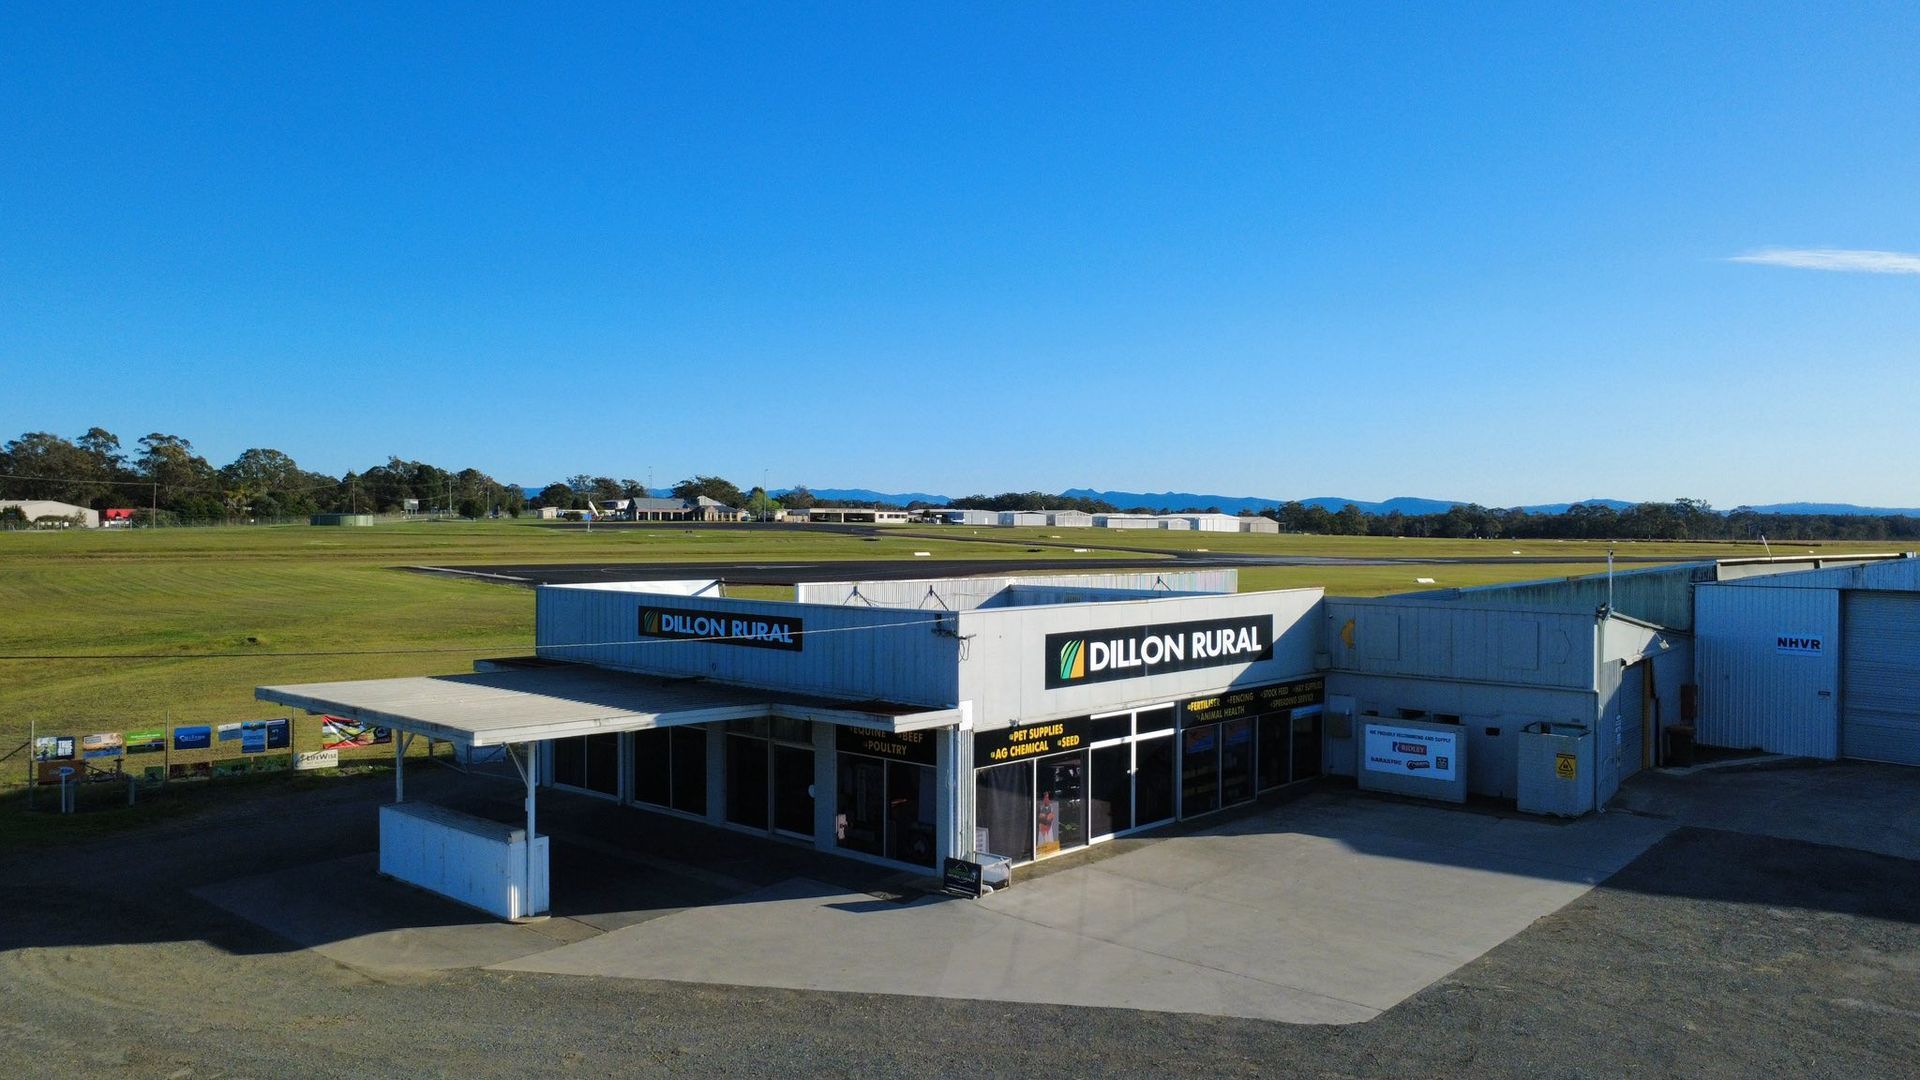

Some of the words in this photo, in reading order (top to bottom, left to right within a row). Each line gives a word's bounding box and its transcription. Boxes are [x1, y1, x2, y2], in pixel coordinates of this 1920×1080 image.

[661, 613, 725, 638] DILLON
[731, 619, 794, 644] RURAL
[1089, 634, 1184, 672] DILLON
[1192, 626, 1262, 660] RURAL
[1777, 637, 1821, 649] NHVR
[1190, 697, 1221, 712] FERTILISER
[1230, 692, 1254, 704] FENCING
[1200, 710, 1223, 721] ANIMAL
[1224, 705, 1245, 716] HEALTH
[853, 727, 886, 738] EQUINE
[903, 730, 923, 743] BEEF
[1013, 730, 1028, 742] PET
[1029, 724, 1064, 740] SUPPLIES
[868, 740, 907, 755] POULTRY
[995, 747, 1008, 760] AG
[1010, 740, 1049, 757] CHEMICAL
[1061, 735, 1080, 748] SEED
